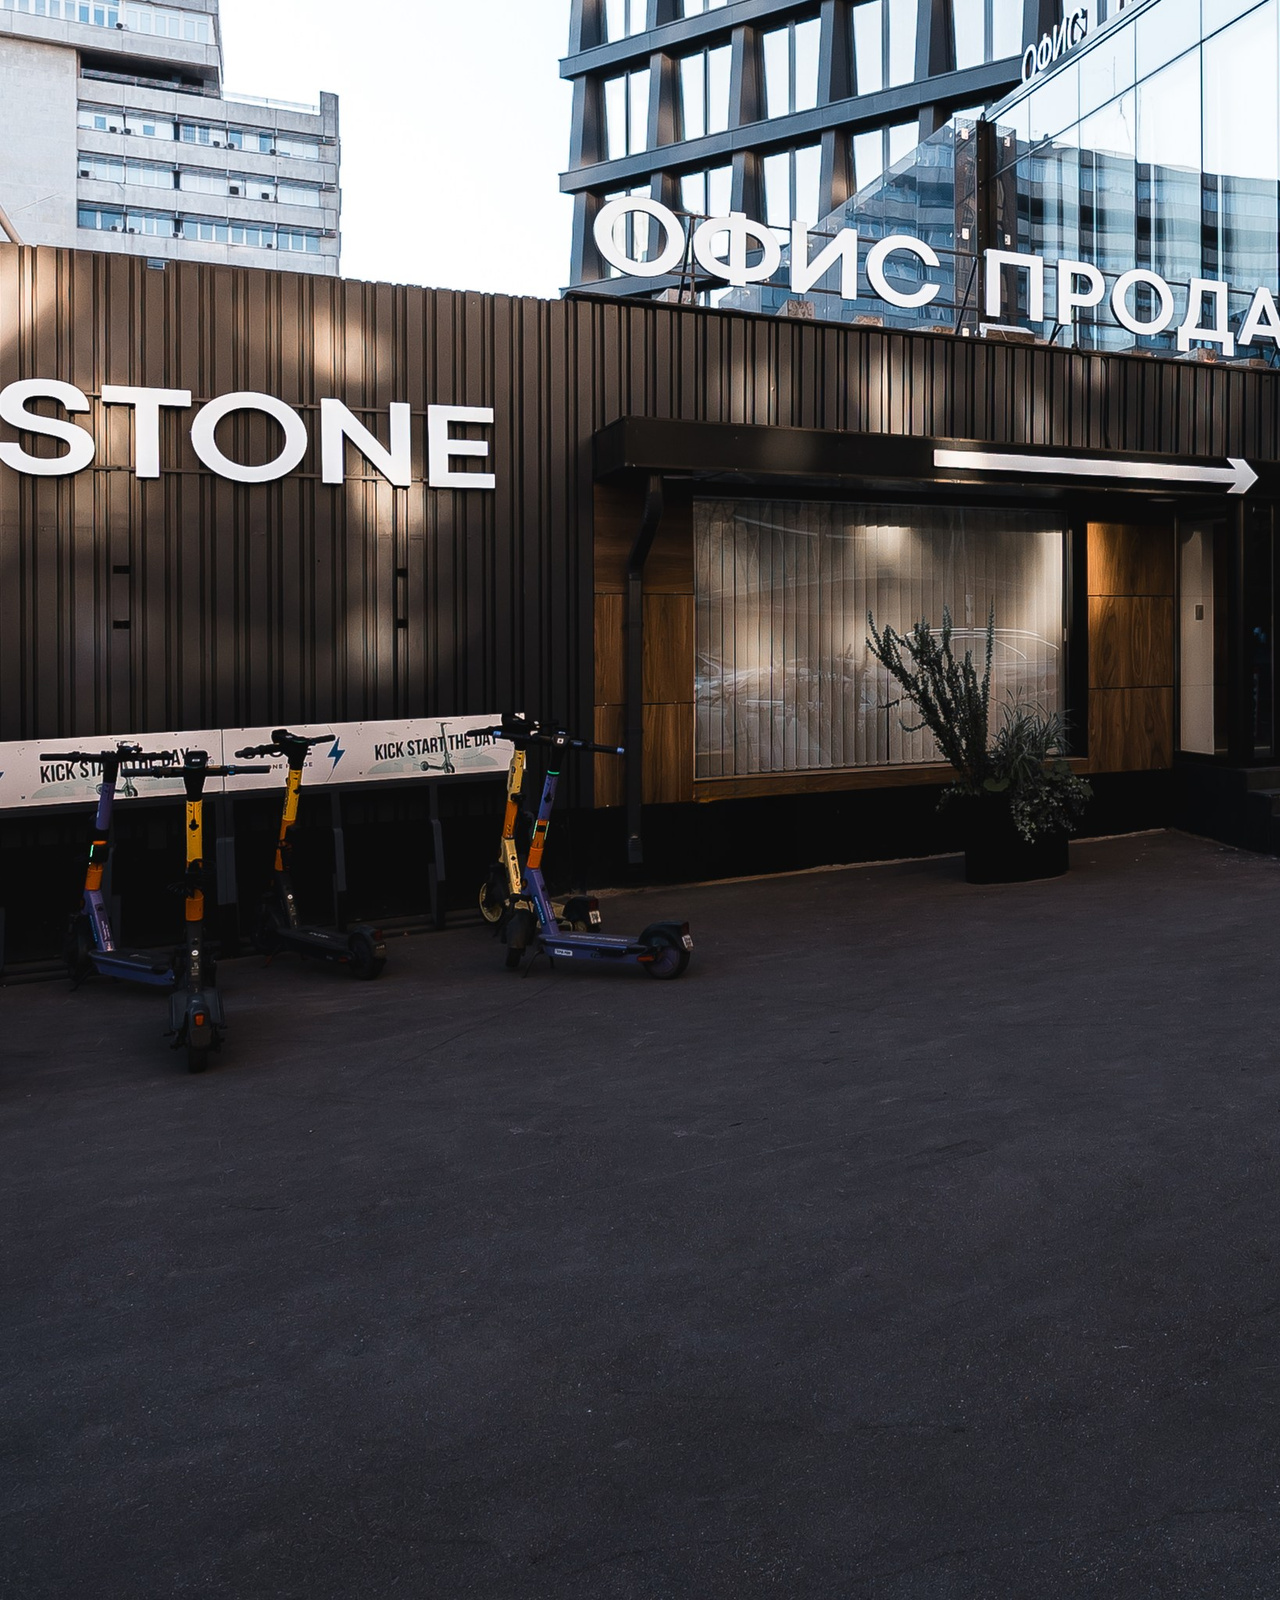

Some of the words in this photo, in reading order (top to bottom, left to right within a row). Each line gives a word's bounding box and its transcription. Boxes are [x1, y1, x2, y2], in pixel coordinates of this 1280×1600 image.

[1021, 6, 1088, 84] ОФИС
[592, 196, 941, 309] ОФИС
[0, 378, 496, 490] STONE
[40, 761, 76, 784] KICK
[375, 742, 404, 761] KICK
[407, 736, 446, 756] START
[448, 733, 471, 750] THE
